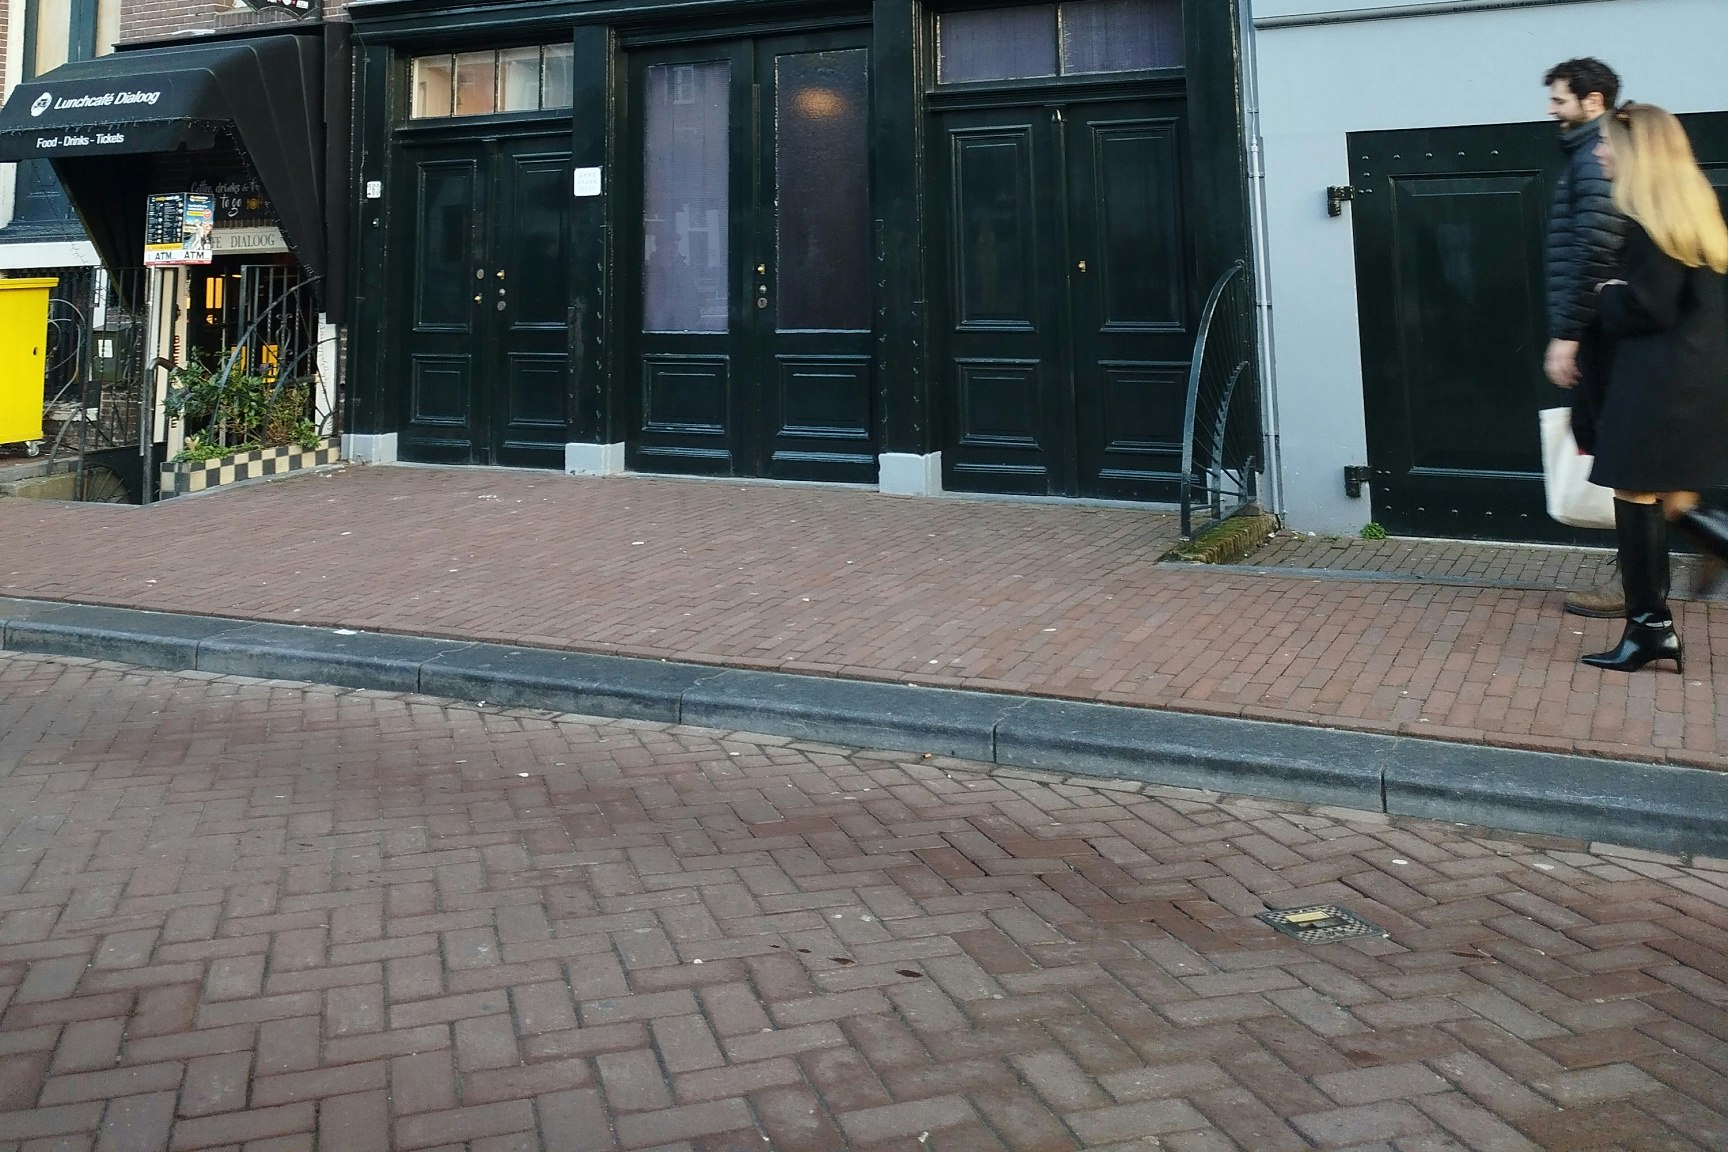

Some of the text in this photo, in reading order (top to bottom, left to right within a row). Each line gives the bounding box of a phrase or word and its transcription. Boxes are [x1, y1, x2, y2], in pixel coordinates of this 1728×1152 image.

[54, 91, 160, 109] Lunchcafé Dialoog
[36, 137, 58, 148] Food
[63, 135, 89, 146] Drinks
[96, 133, 124, 144] Tickets
[228, 198, 242, 217] go
[230, 234, 275, 248] DIALOOG
[155, 251, 205, 260] ATM ATM
